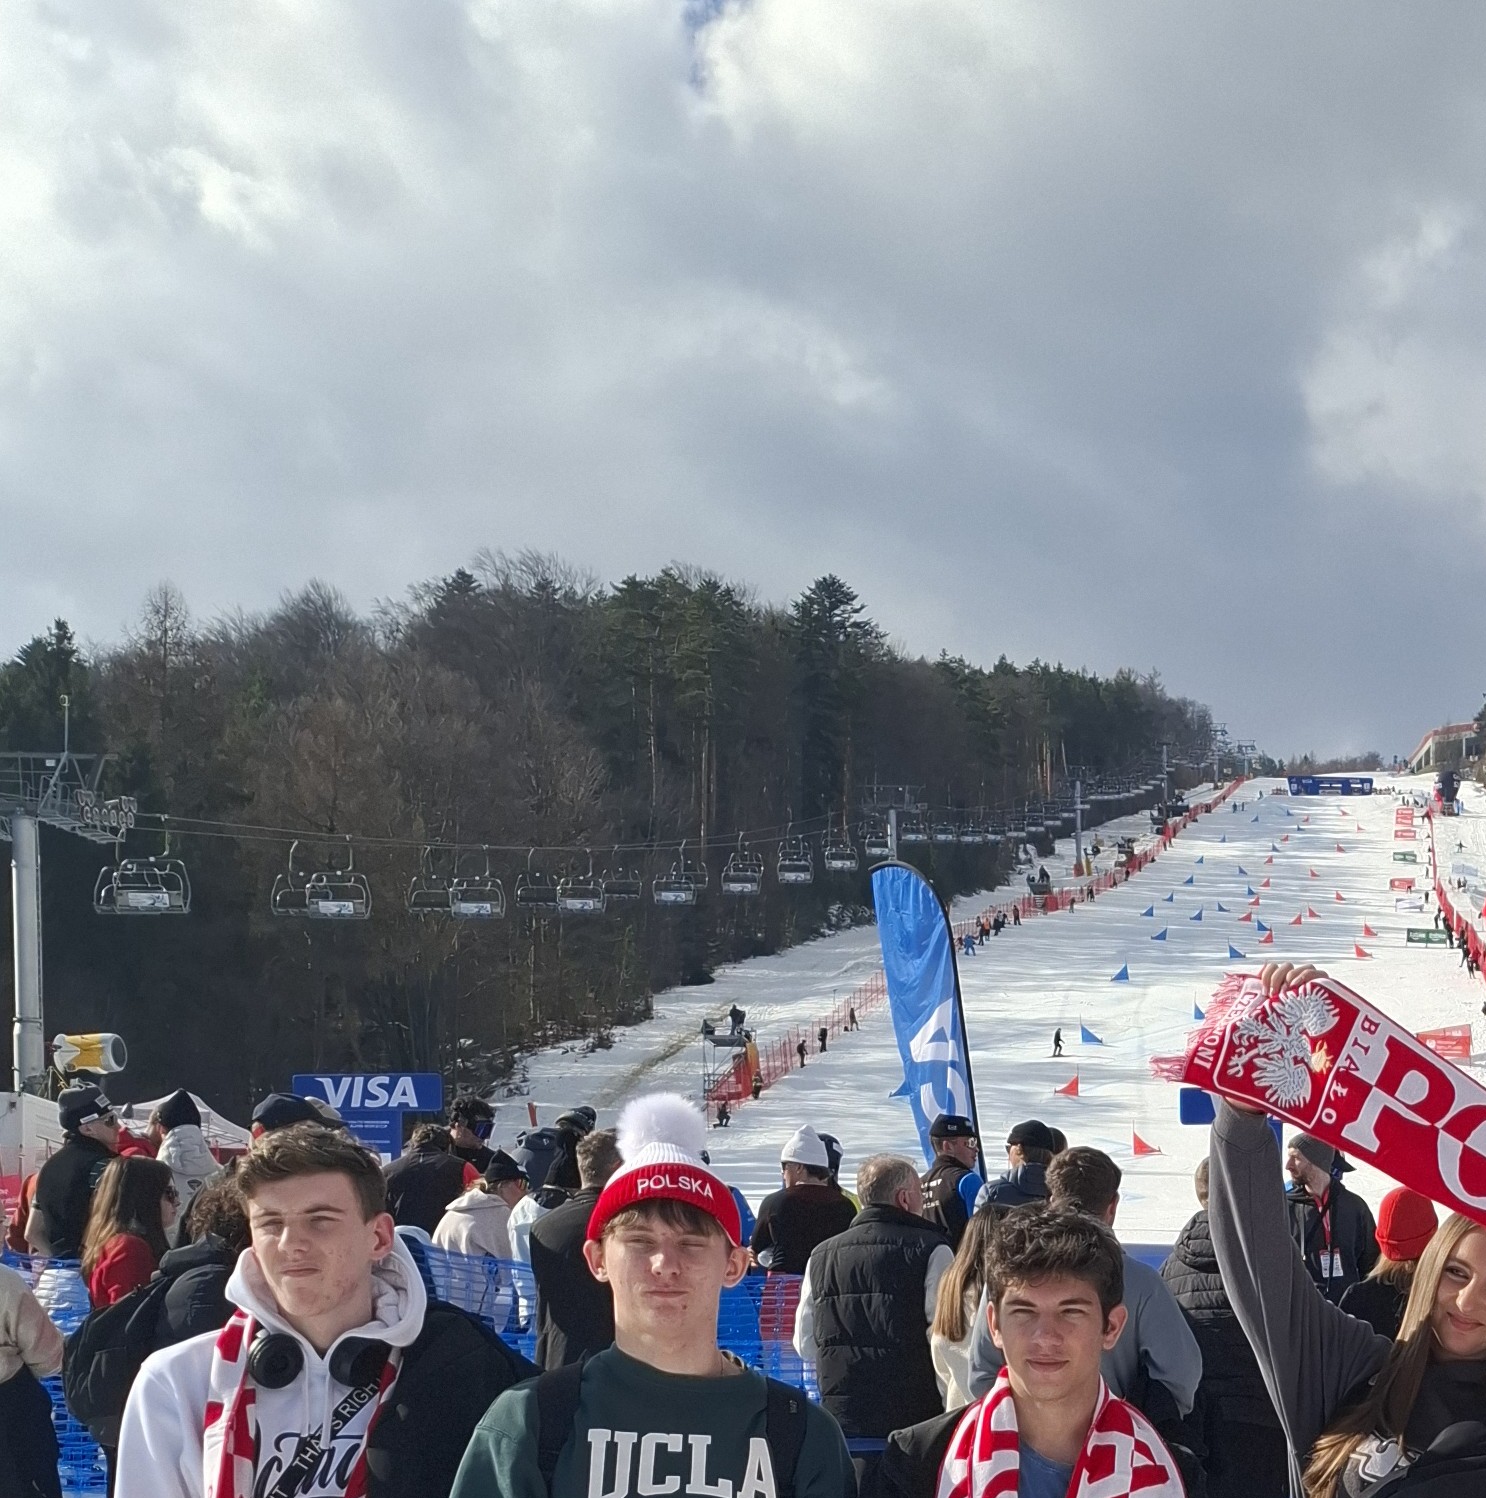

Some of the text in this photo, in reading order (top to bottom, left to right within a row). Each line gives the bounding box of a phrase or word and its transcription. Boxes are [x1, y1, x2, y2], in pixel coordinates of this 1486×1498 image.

[1194, 991, 1259, 1069] CZEONI
[314, 1076, 419, 1108] VISA
[1322, 1015, 1382, 1124] BIAŁO
[636, 1174, 714, 1199] POLSKA
[292, 1416, 344, 1470] THAS
[338, 1378, 381, 1418] RIGH
